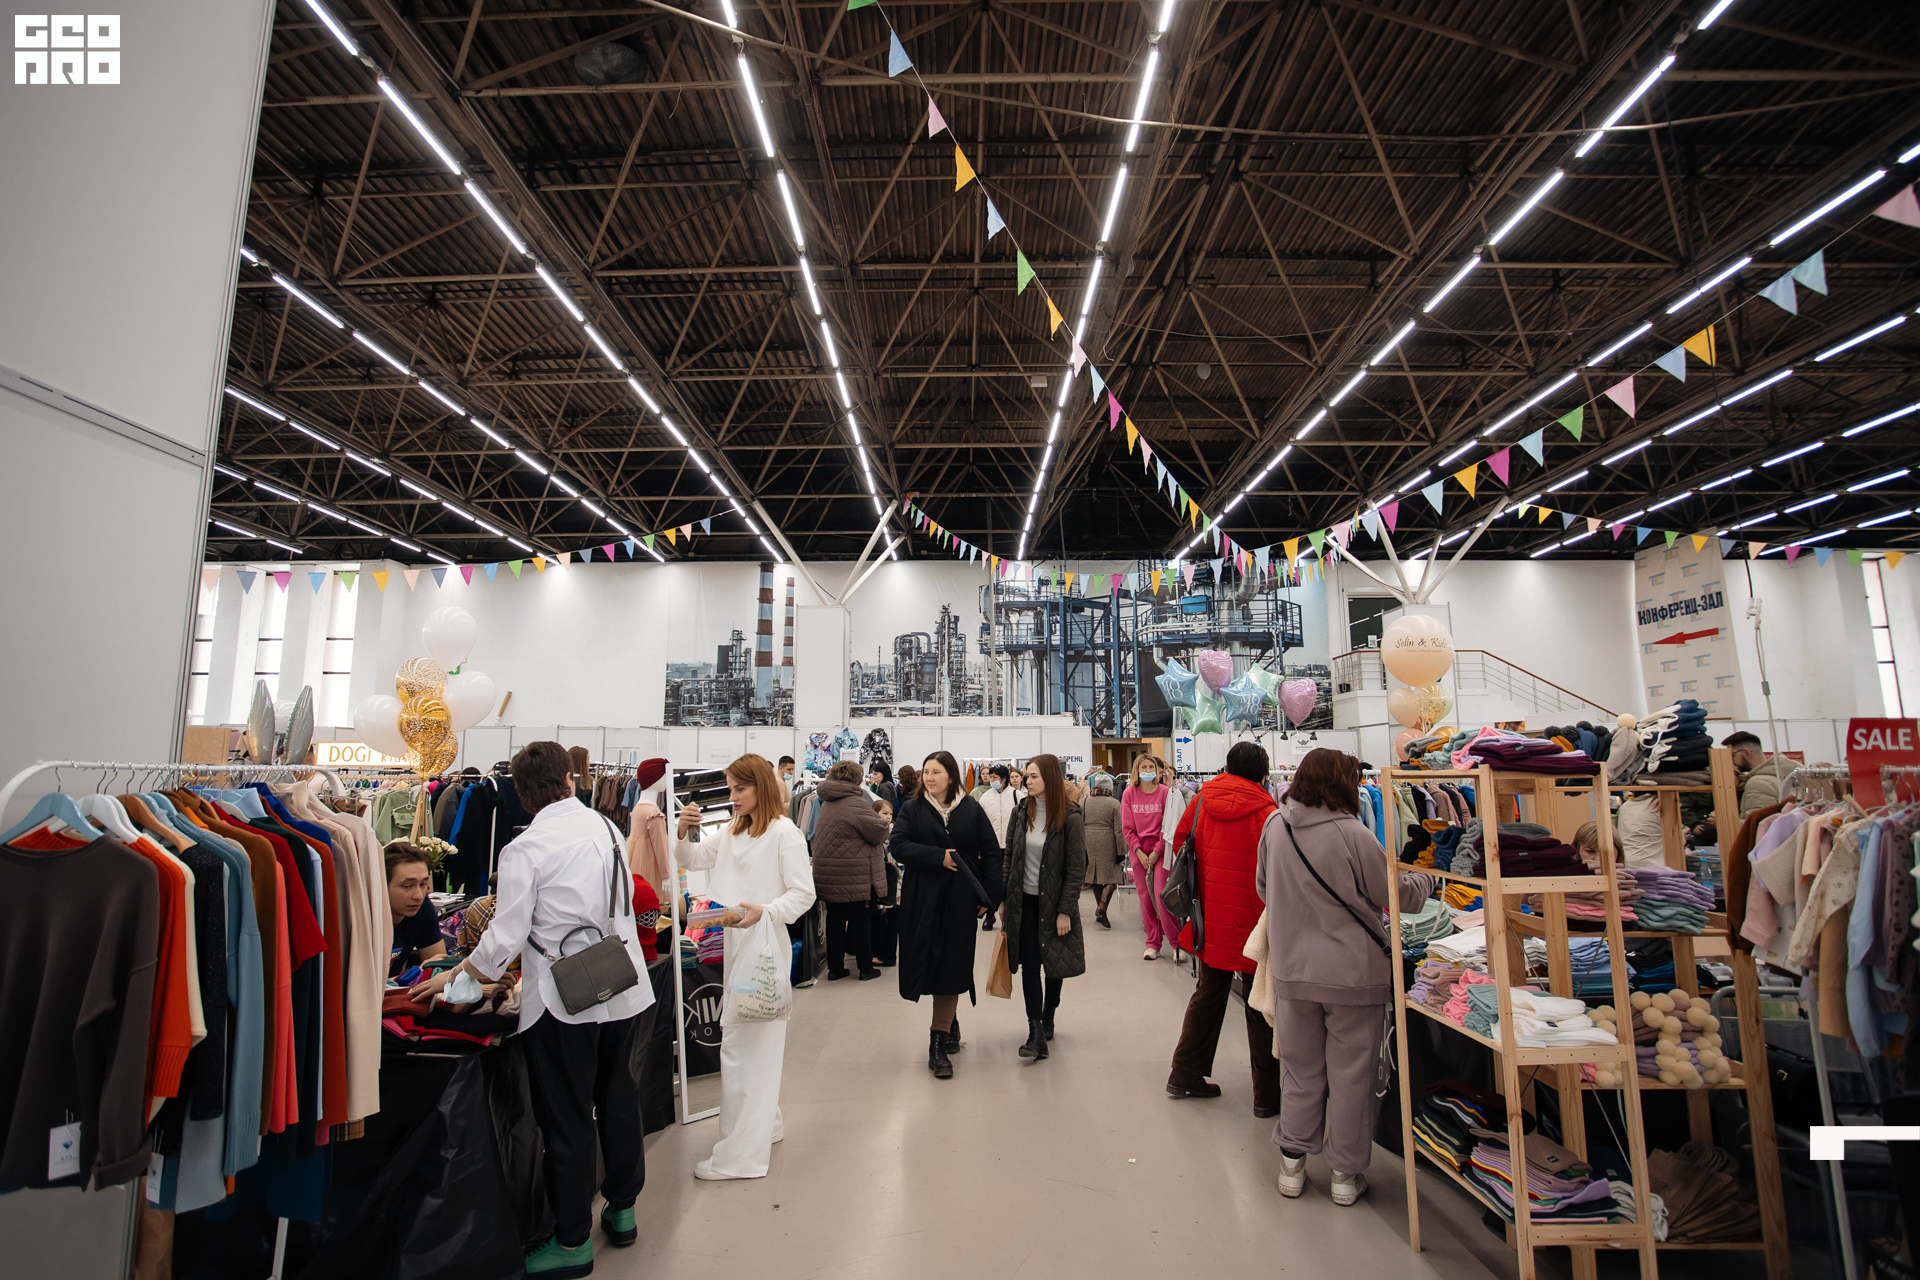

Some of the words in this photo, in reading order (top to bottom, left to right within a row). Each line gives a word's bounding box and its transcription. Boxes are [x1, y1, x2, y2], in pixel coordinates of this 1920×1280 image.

[1637, 591, 1724, 626] КОНФЕРЕНЦ-ЗАЛ
[1395, 635, 1414, 648] Selin
[1418, 637, 1427, 648] &
[1852, 728, 1914, 751] SALE
